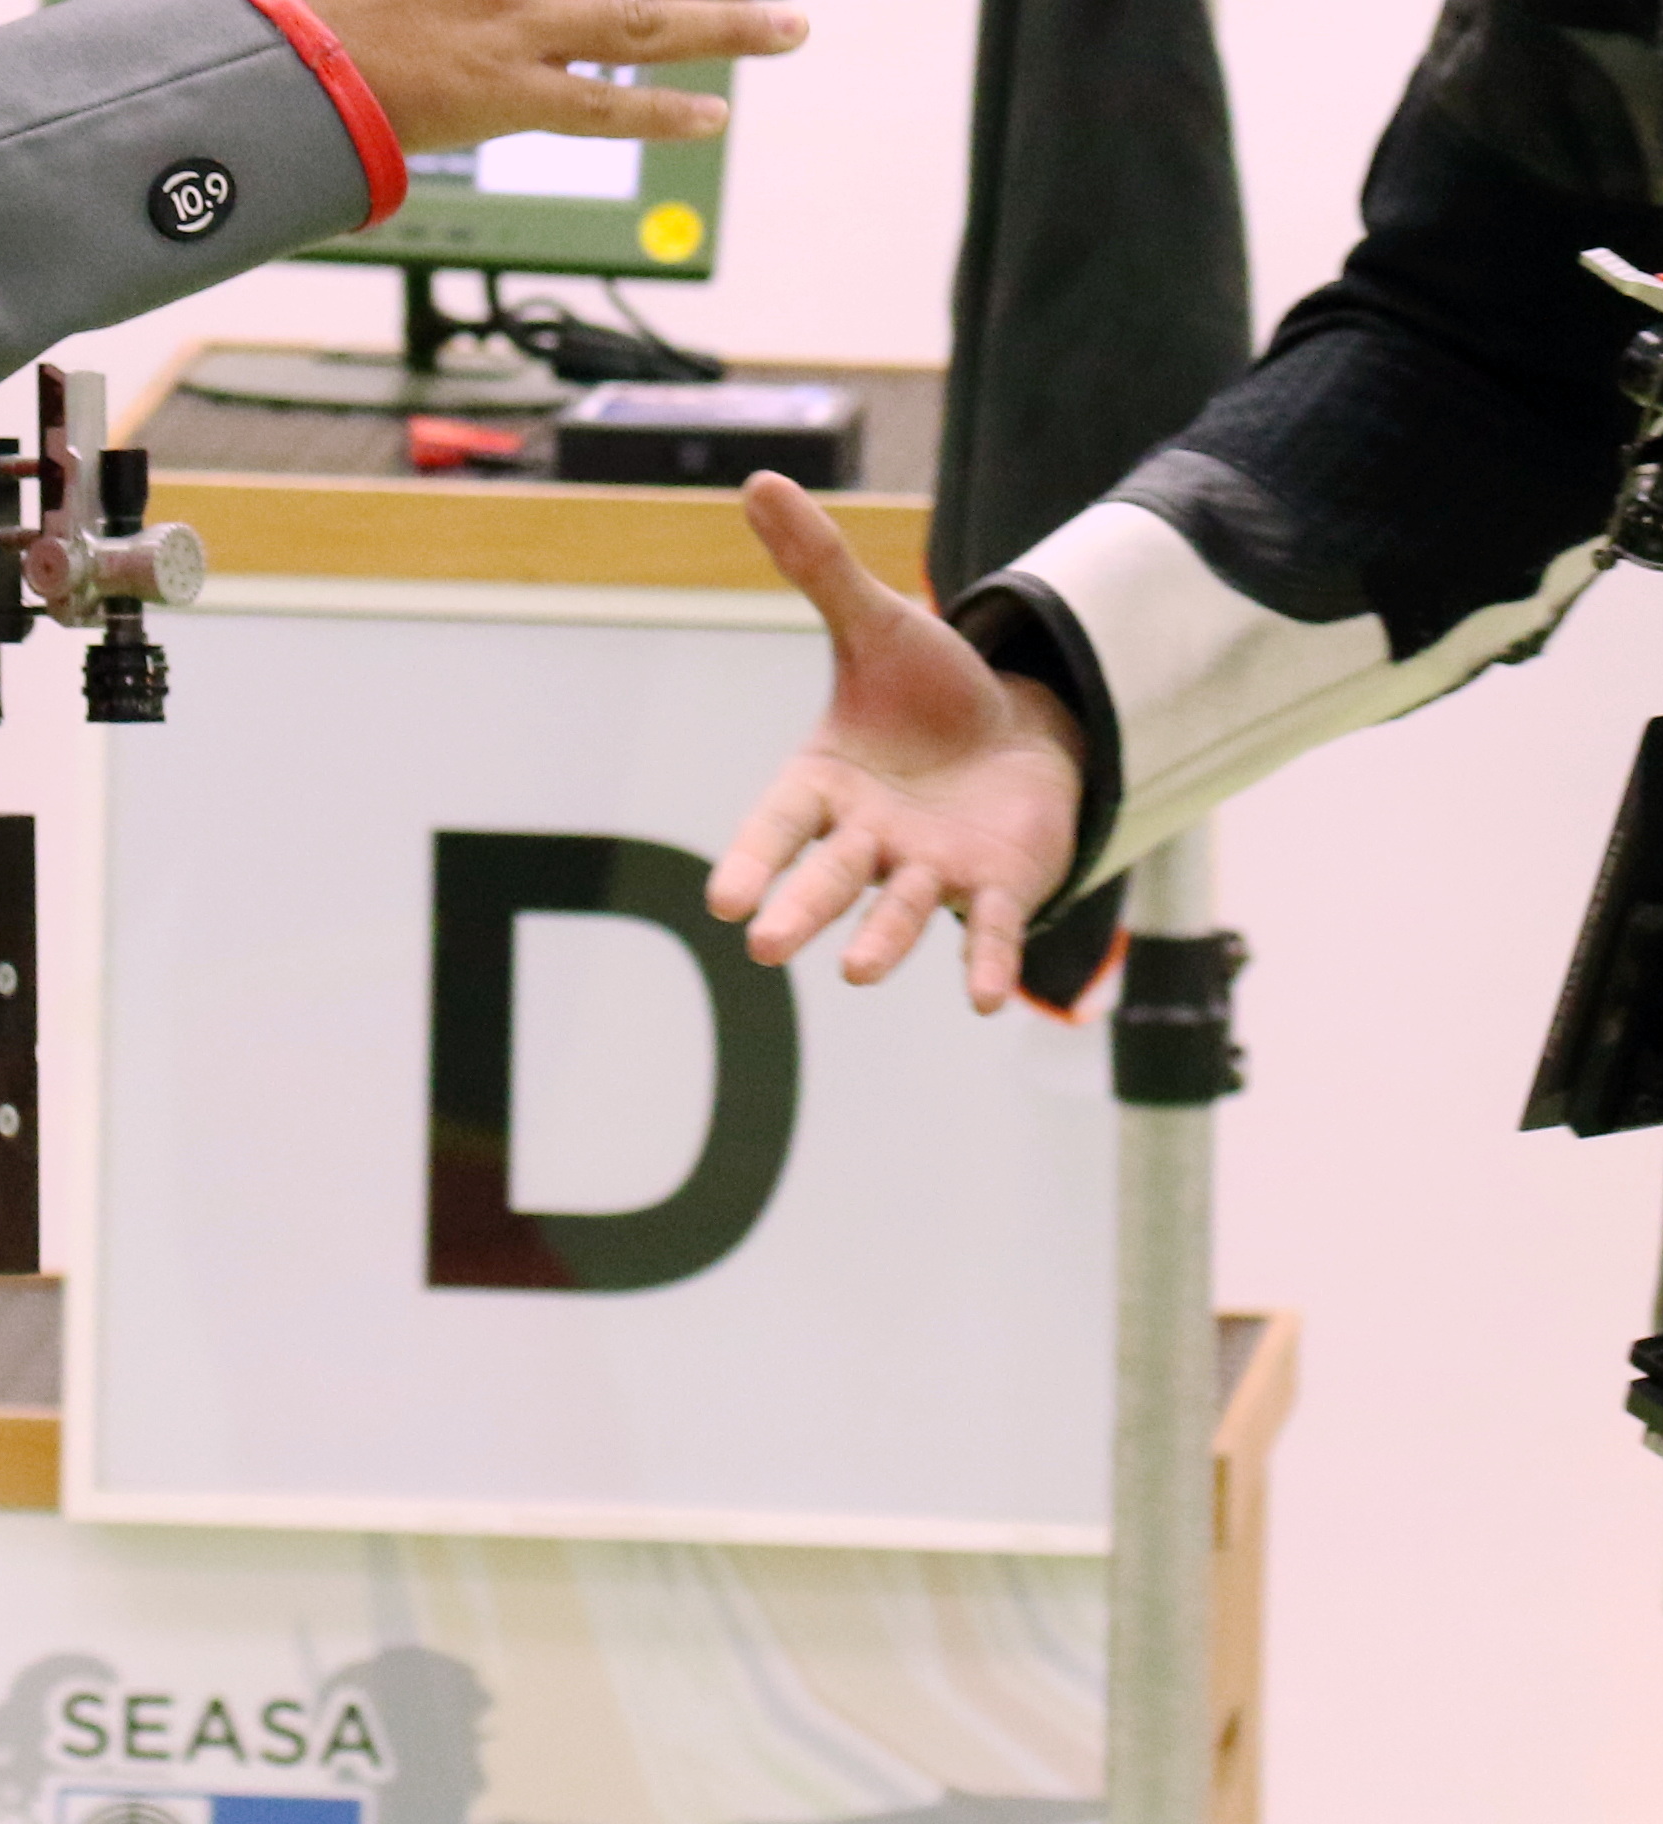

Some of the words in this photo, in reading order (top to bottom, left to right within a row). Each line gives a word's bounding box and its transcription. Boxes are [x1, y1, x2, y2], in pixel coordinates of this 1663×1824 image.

[170, 171, 229, 222] 10.9
[425, 829, 803, 1297] D
[60, 1691, 381, 1768] SEASA
